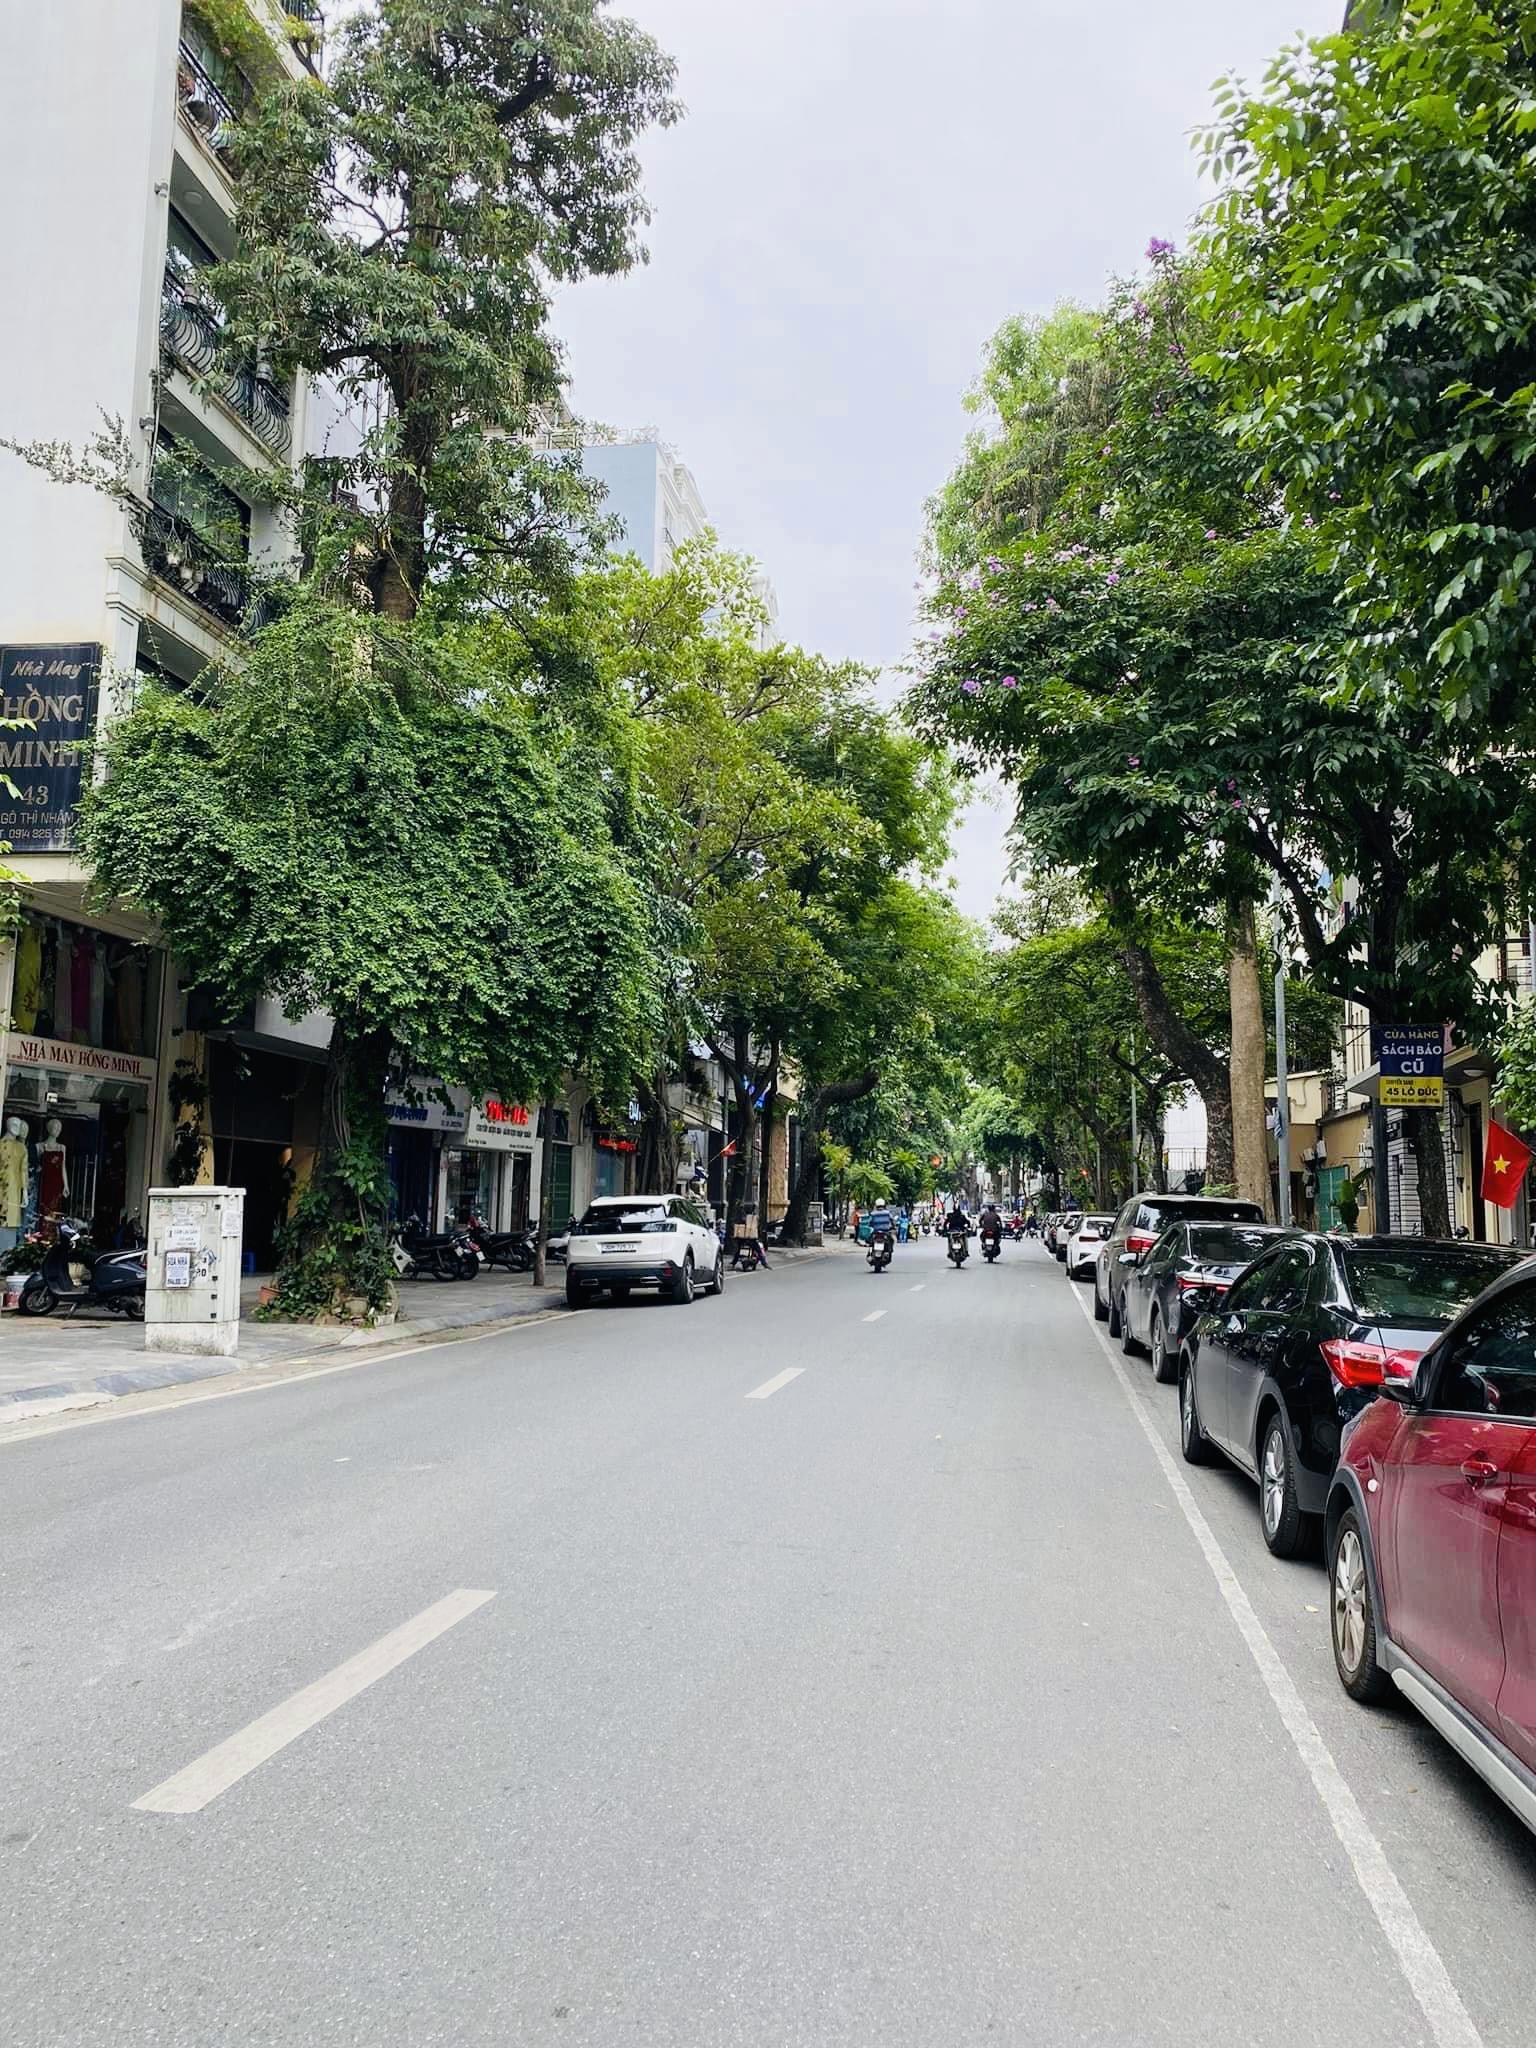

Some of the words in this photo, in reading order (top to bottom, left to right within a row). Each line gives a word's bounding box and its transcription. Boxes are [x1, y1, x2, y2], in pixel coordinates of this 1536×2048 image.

[10, 660, 45, 677] Nhà
[45, 660, 82, 680] May
[3, 683, 84, 722] HỒNG
[0, 741, 80, 768] MINH
[23, 785, 49, 806] 43
[0, 810, 17, 825] GÔ
[1408, 1029, 1440, 1039] HÀNG
[20, 1040, 46, 1060] NHÀ
[50, 1046, 77, 1065] MAY
[79, 1048, 110, 1071] HỒNG
[111, 1057, 141, 1074] MINH
[1382, 1043, 1415, 1055] SÁCH
[1416, 1043, 1442, 1055] BÁO
[1400, 1058, 1425, 1074] CŨ
[1386, 1088, 1399, 1096] 45
